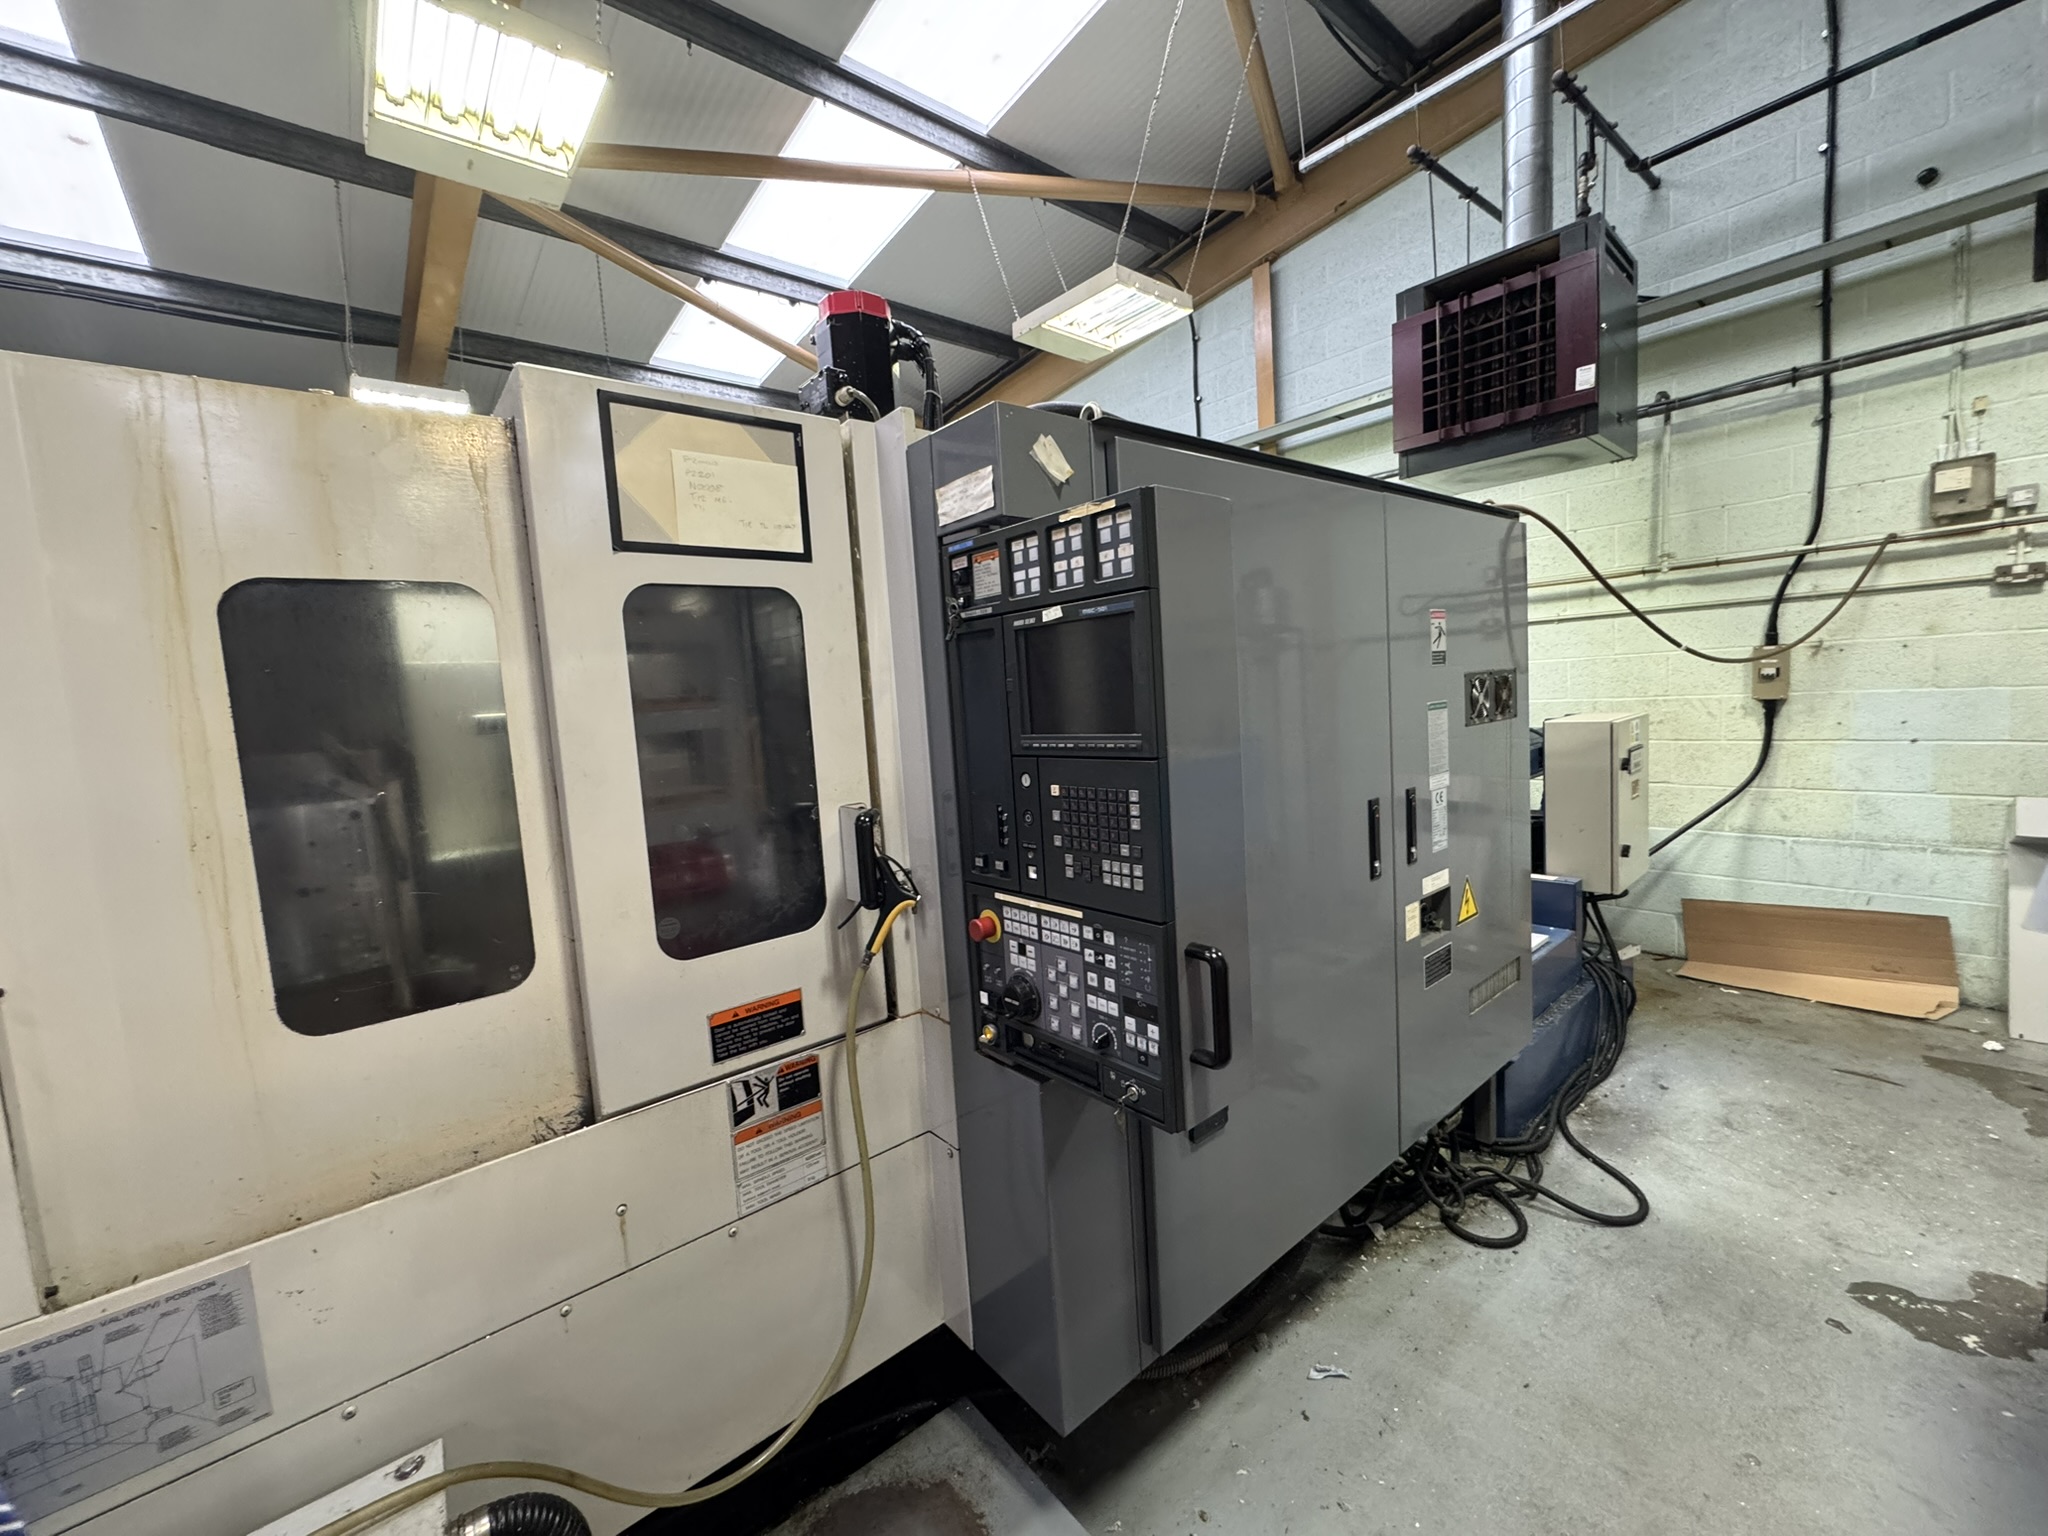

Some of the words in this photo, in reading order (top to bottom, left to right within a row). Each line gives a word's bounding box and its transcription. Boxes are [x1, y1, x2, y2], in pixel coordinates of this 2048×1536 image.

[745, 999, 779, 1013] WARNING
[786, 1056, 816, 1070] WARNING
[17, 1349, 27, 1358] &
[31, 1325, 94, 1351] SOLENOID
[165, 1280, 216, 1304] POSITION
